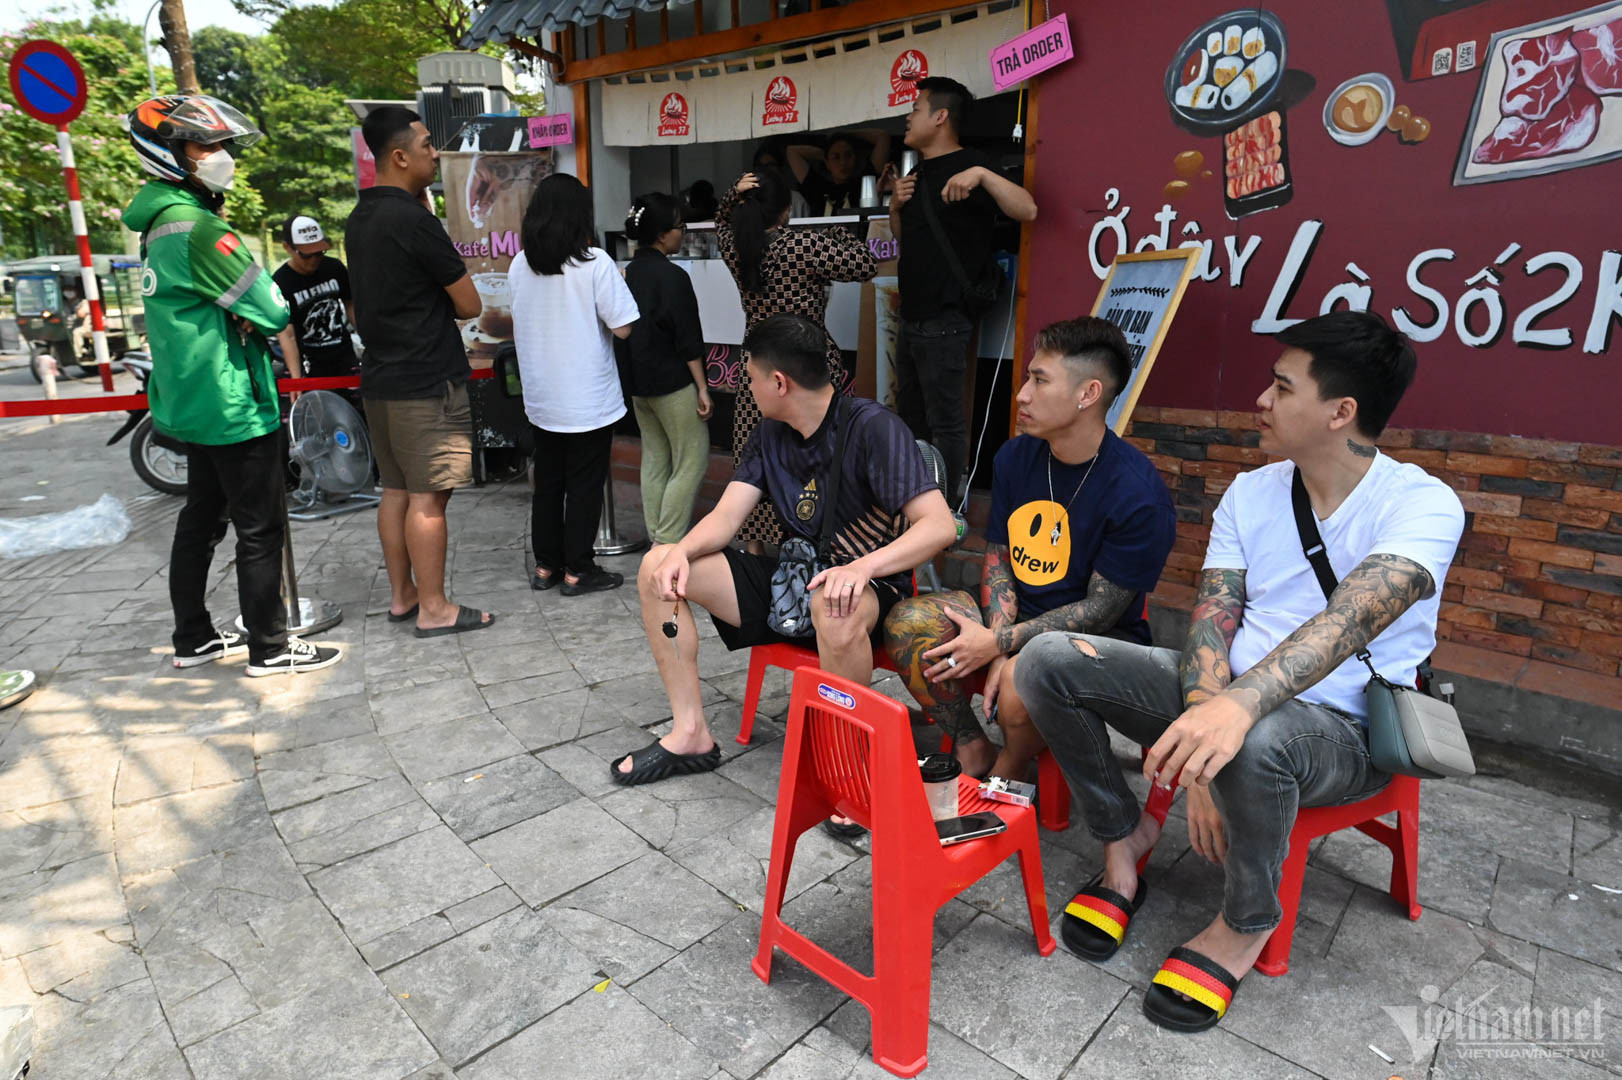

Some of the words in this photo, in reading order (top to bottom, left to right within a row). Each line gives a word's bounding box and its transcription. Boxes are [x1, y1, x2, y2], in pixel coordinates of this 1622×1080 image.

[997, 47, 1021, 77] TRẢ
[1022, 32, 1064, 65] ORDER
[1012, 545, 1060, 574] drew
